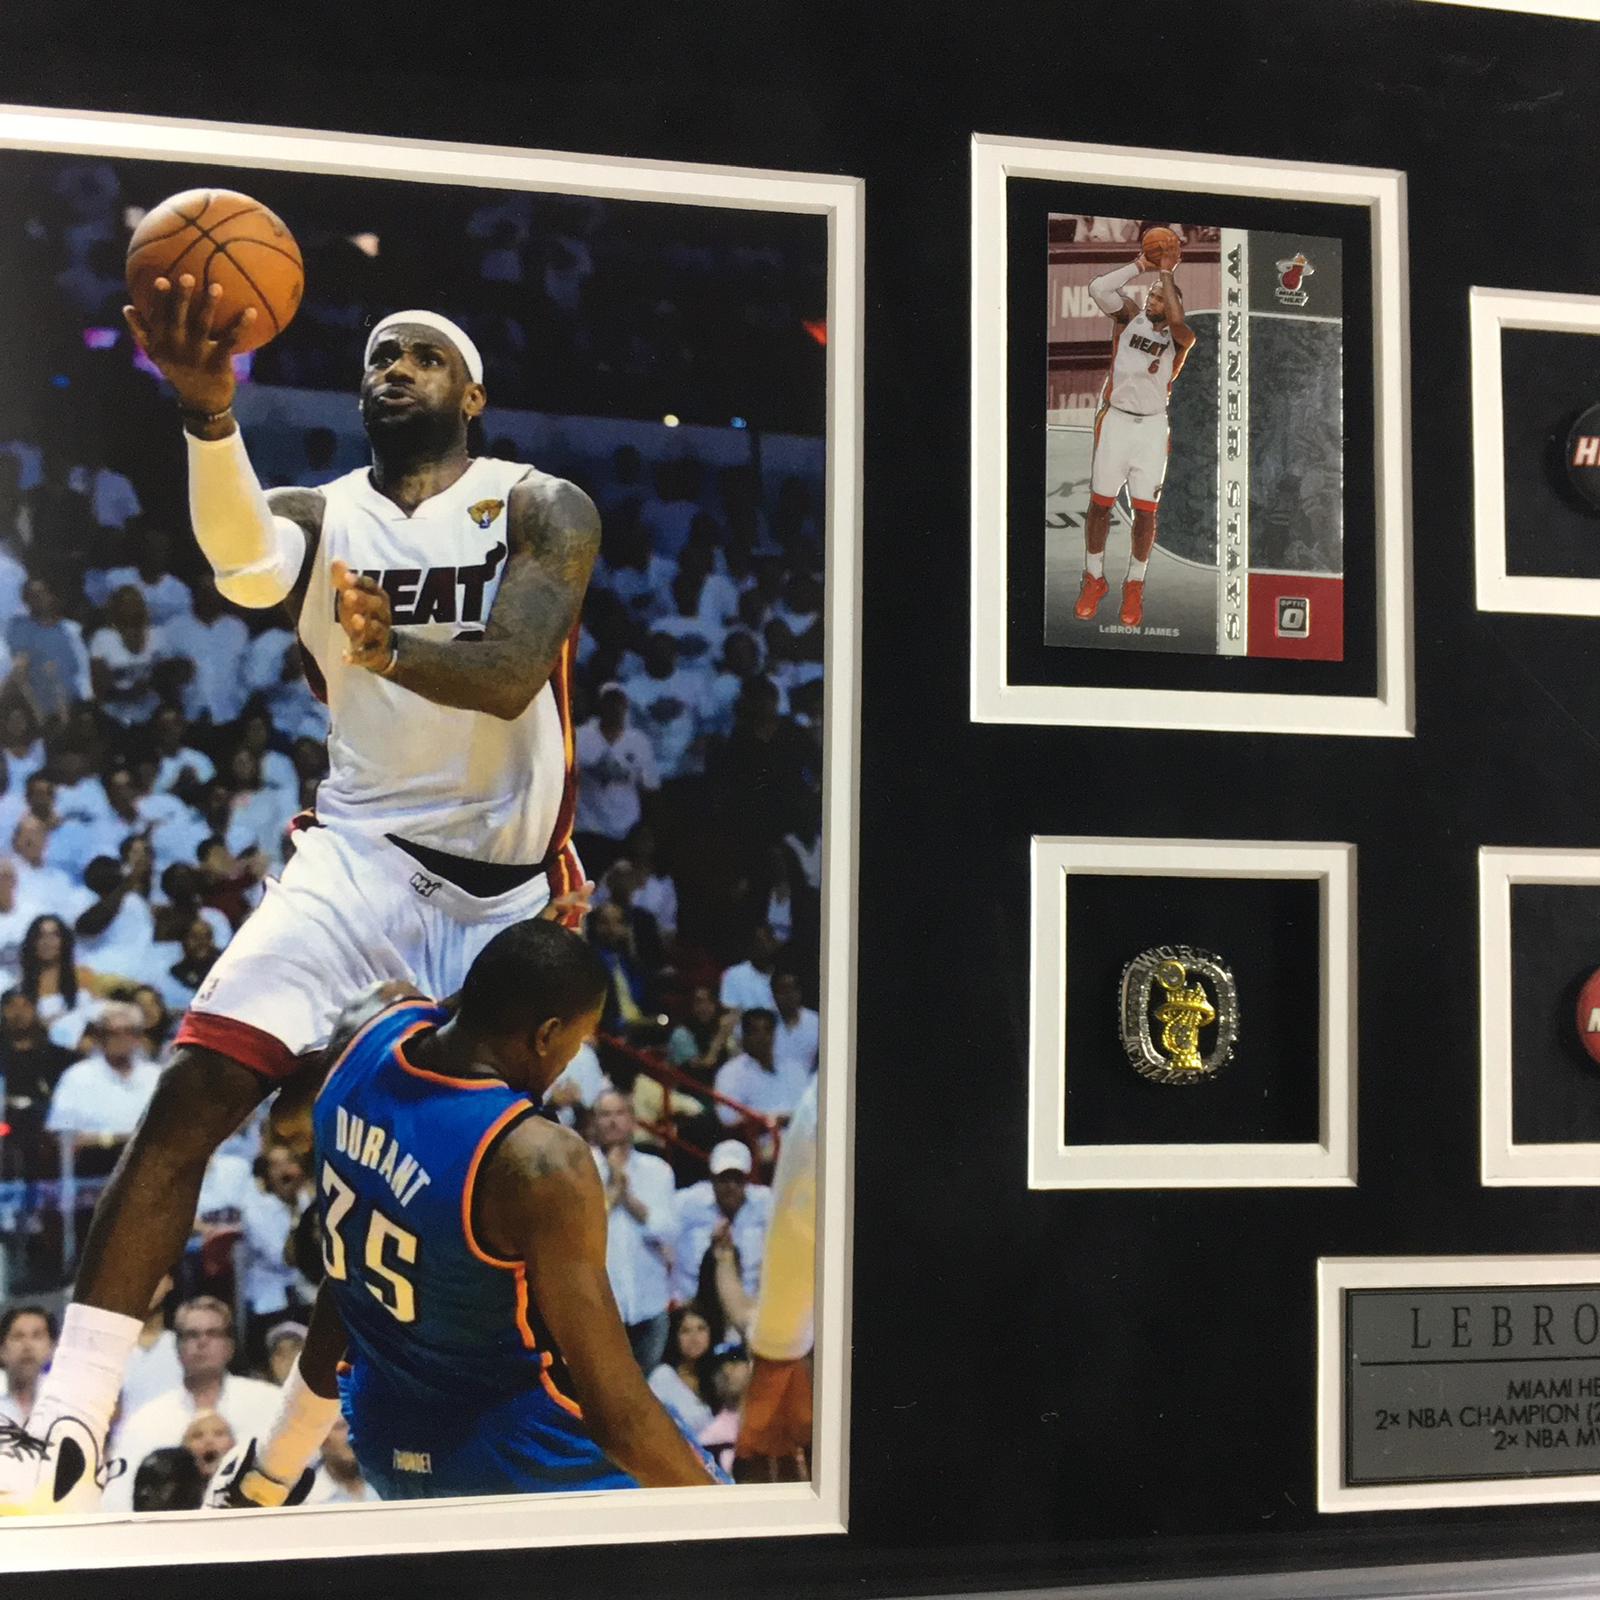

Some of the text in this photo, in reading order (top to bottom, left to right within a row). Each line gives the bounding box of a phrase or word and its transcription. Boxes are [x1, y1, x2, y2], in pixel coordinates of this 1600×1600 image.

[1128, 333, 1170, 357] HEAT
[1148, 359, 1160, 374] 6
[1225, 243, 1242, 641] WINNER STAYS
[1571, 435, 1600, 468] H
[334, 541, 506, 628] EAT
[1144, 626, 1180, 637] JAMES
[335, 1105, 432, 1208] DURANT
[321, 1160, 418, 1323] 35
[1506, 1377, 1573, 1400] MIAMI
[1407, 1408, 1453, 1428] NBA
[1459, 1403, 1580, 1427] CHAMPION
[1525, 1429, 1570, 1448] NBA
